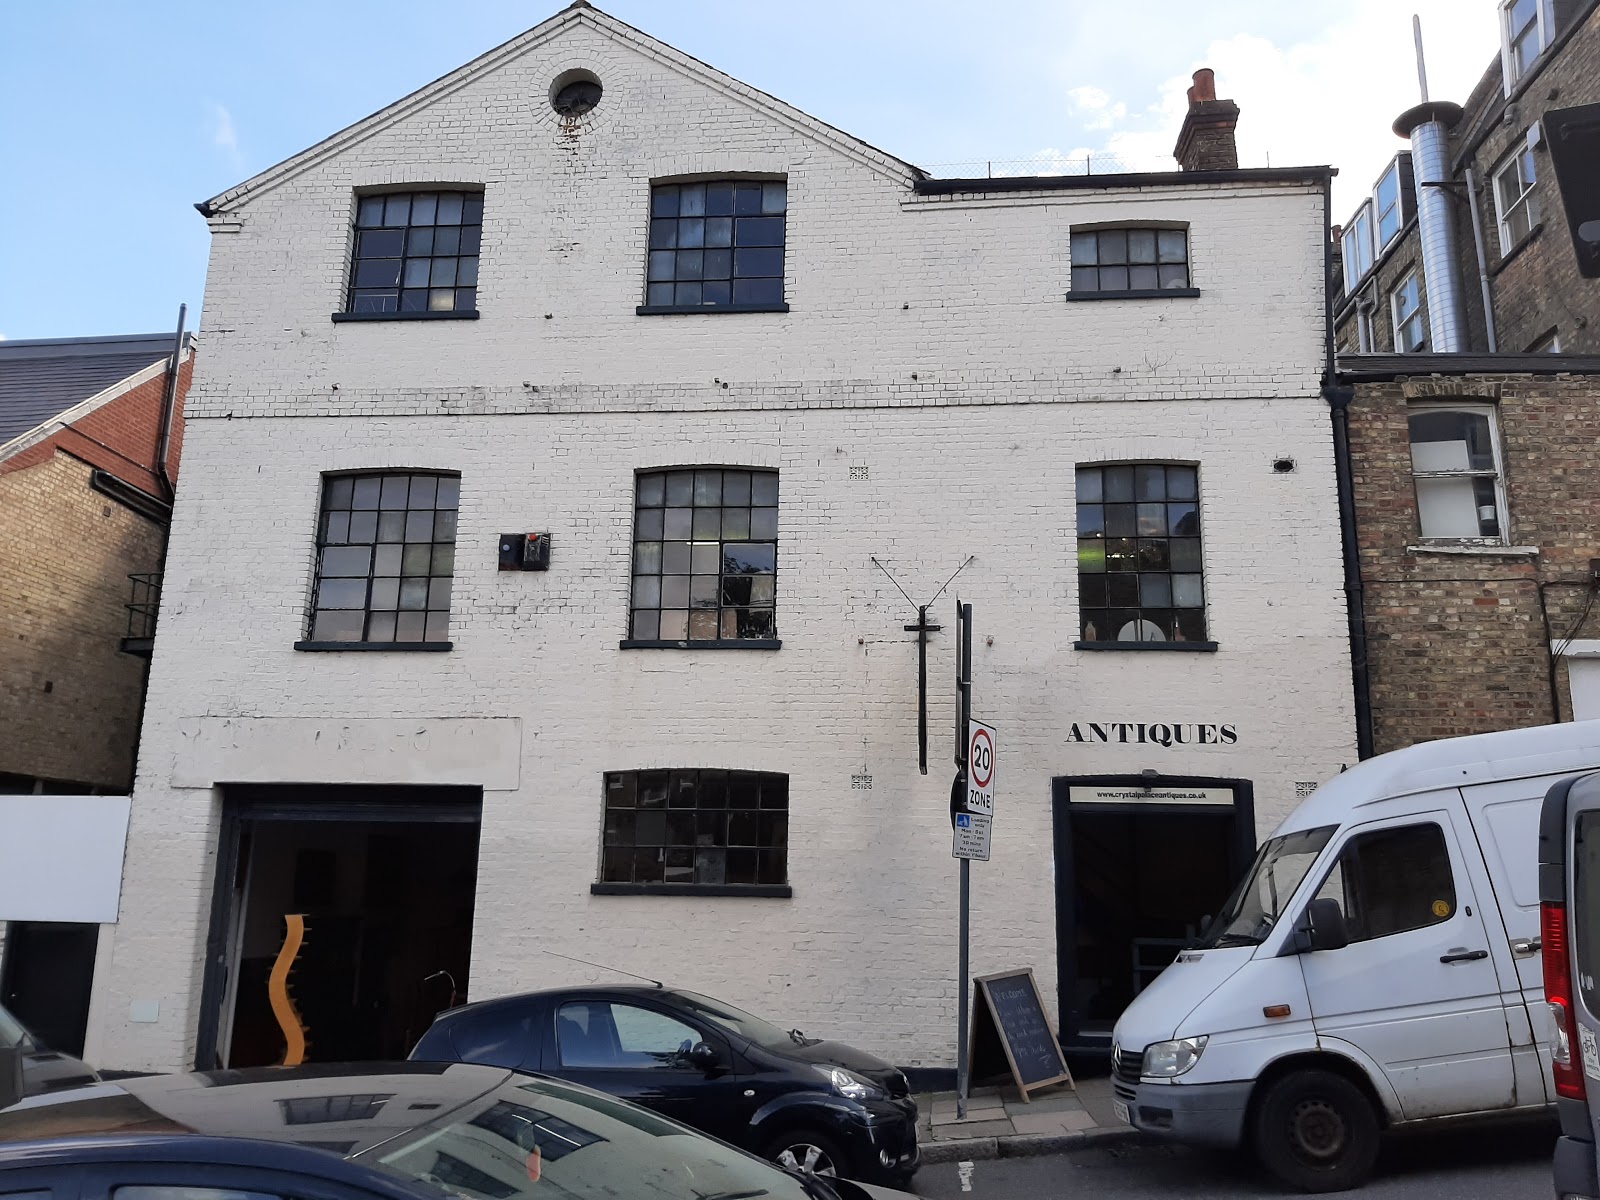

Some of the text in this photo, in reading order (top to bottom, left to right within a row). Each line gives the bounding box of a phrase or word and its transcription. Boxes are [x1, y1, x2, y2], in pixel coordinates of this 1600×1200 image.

[1064, 722, 1238, 747] ANTIQUES
[974, 744, 990, 771] 20
[970, 789, 990, 808] ZONE
[1096, 791, 1207, 800] www.crystalpalaceantiques.co.uk
